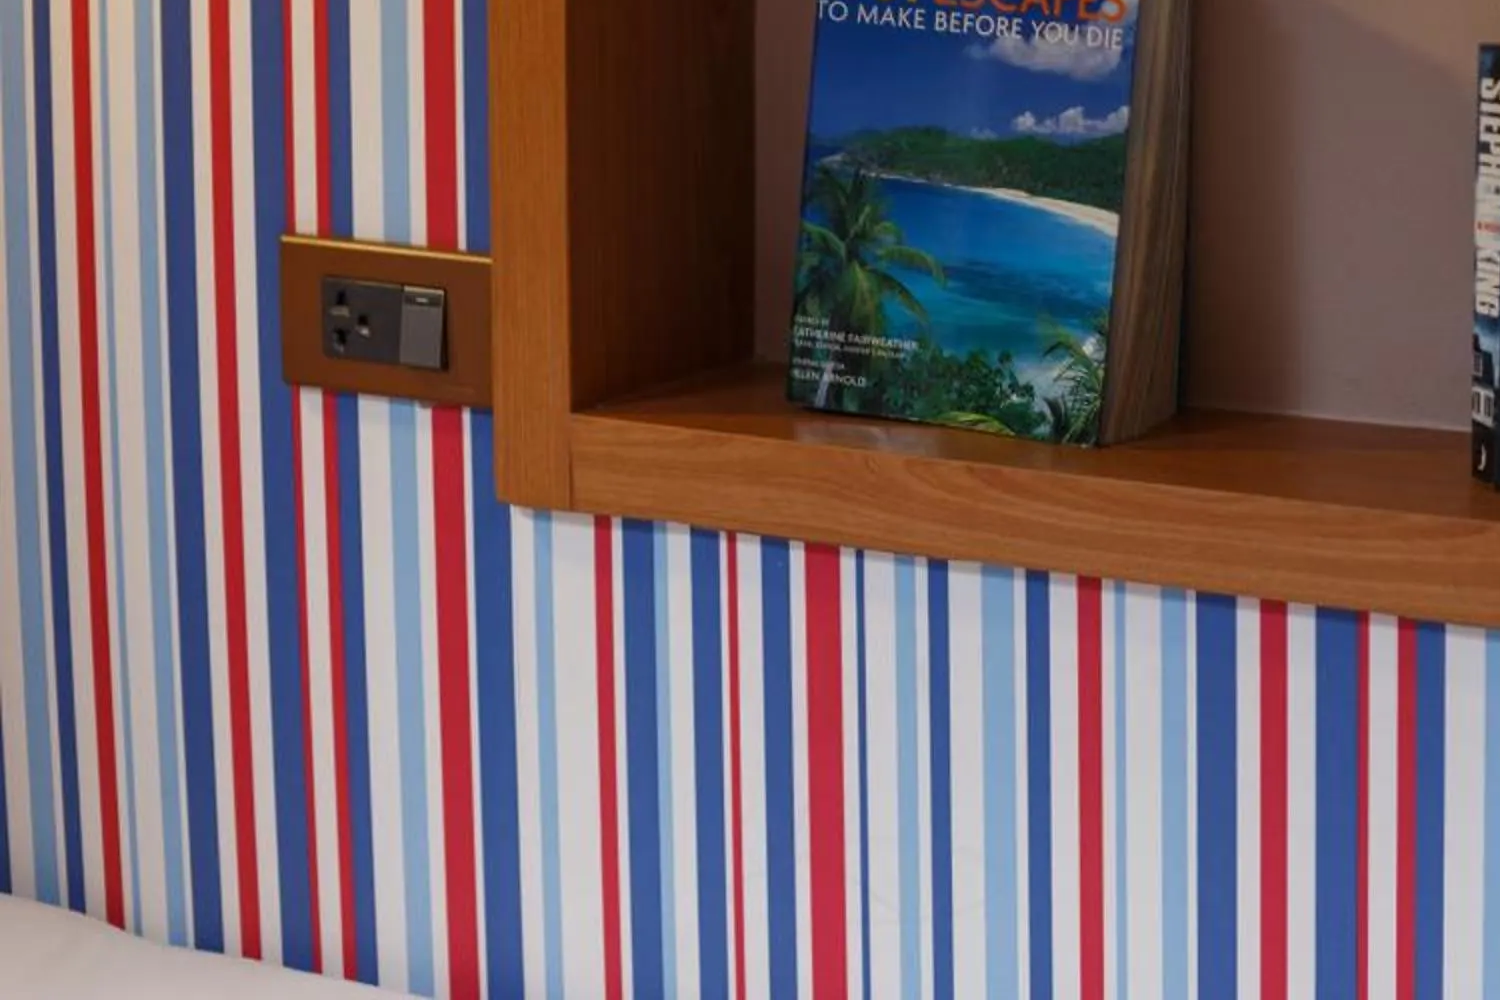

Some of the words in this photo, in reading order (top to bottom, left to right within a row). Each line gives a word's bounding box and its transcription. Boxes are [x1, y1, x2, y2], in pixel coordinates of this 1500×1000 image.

[818, 0, 849, 22] TO
[857, 3, 926, 31] MAKE
[934, 9, 1023, 40] BEFORE
[1032, 19, 1080, 46] YOU
[1086, 28, 1124, 50] DIE
